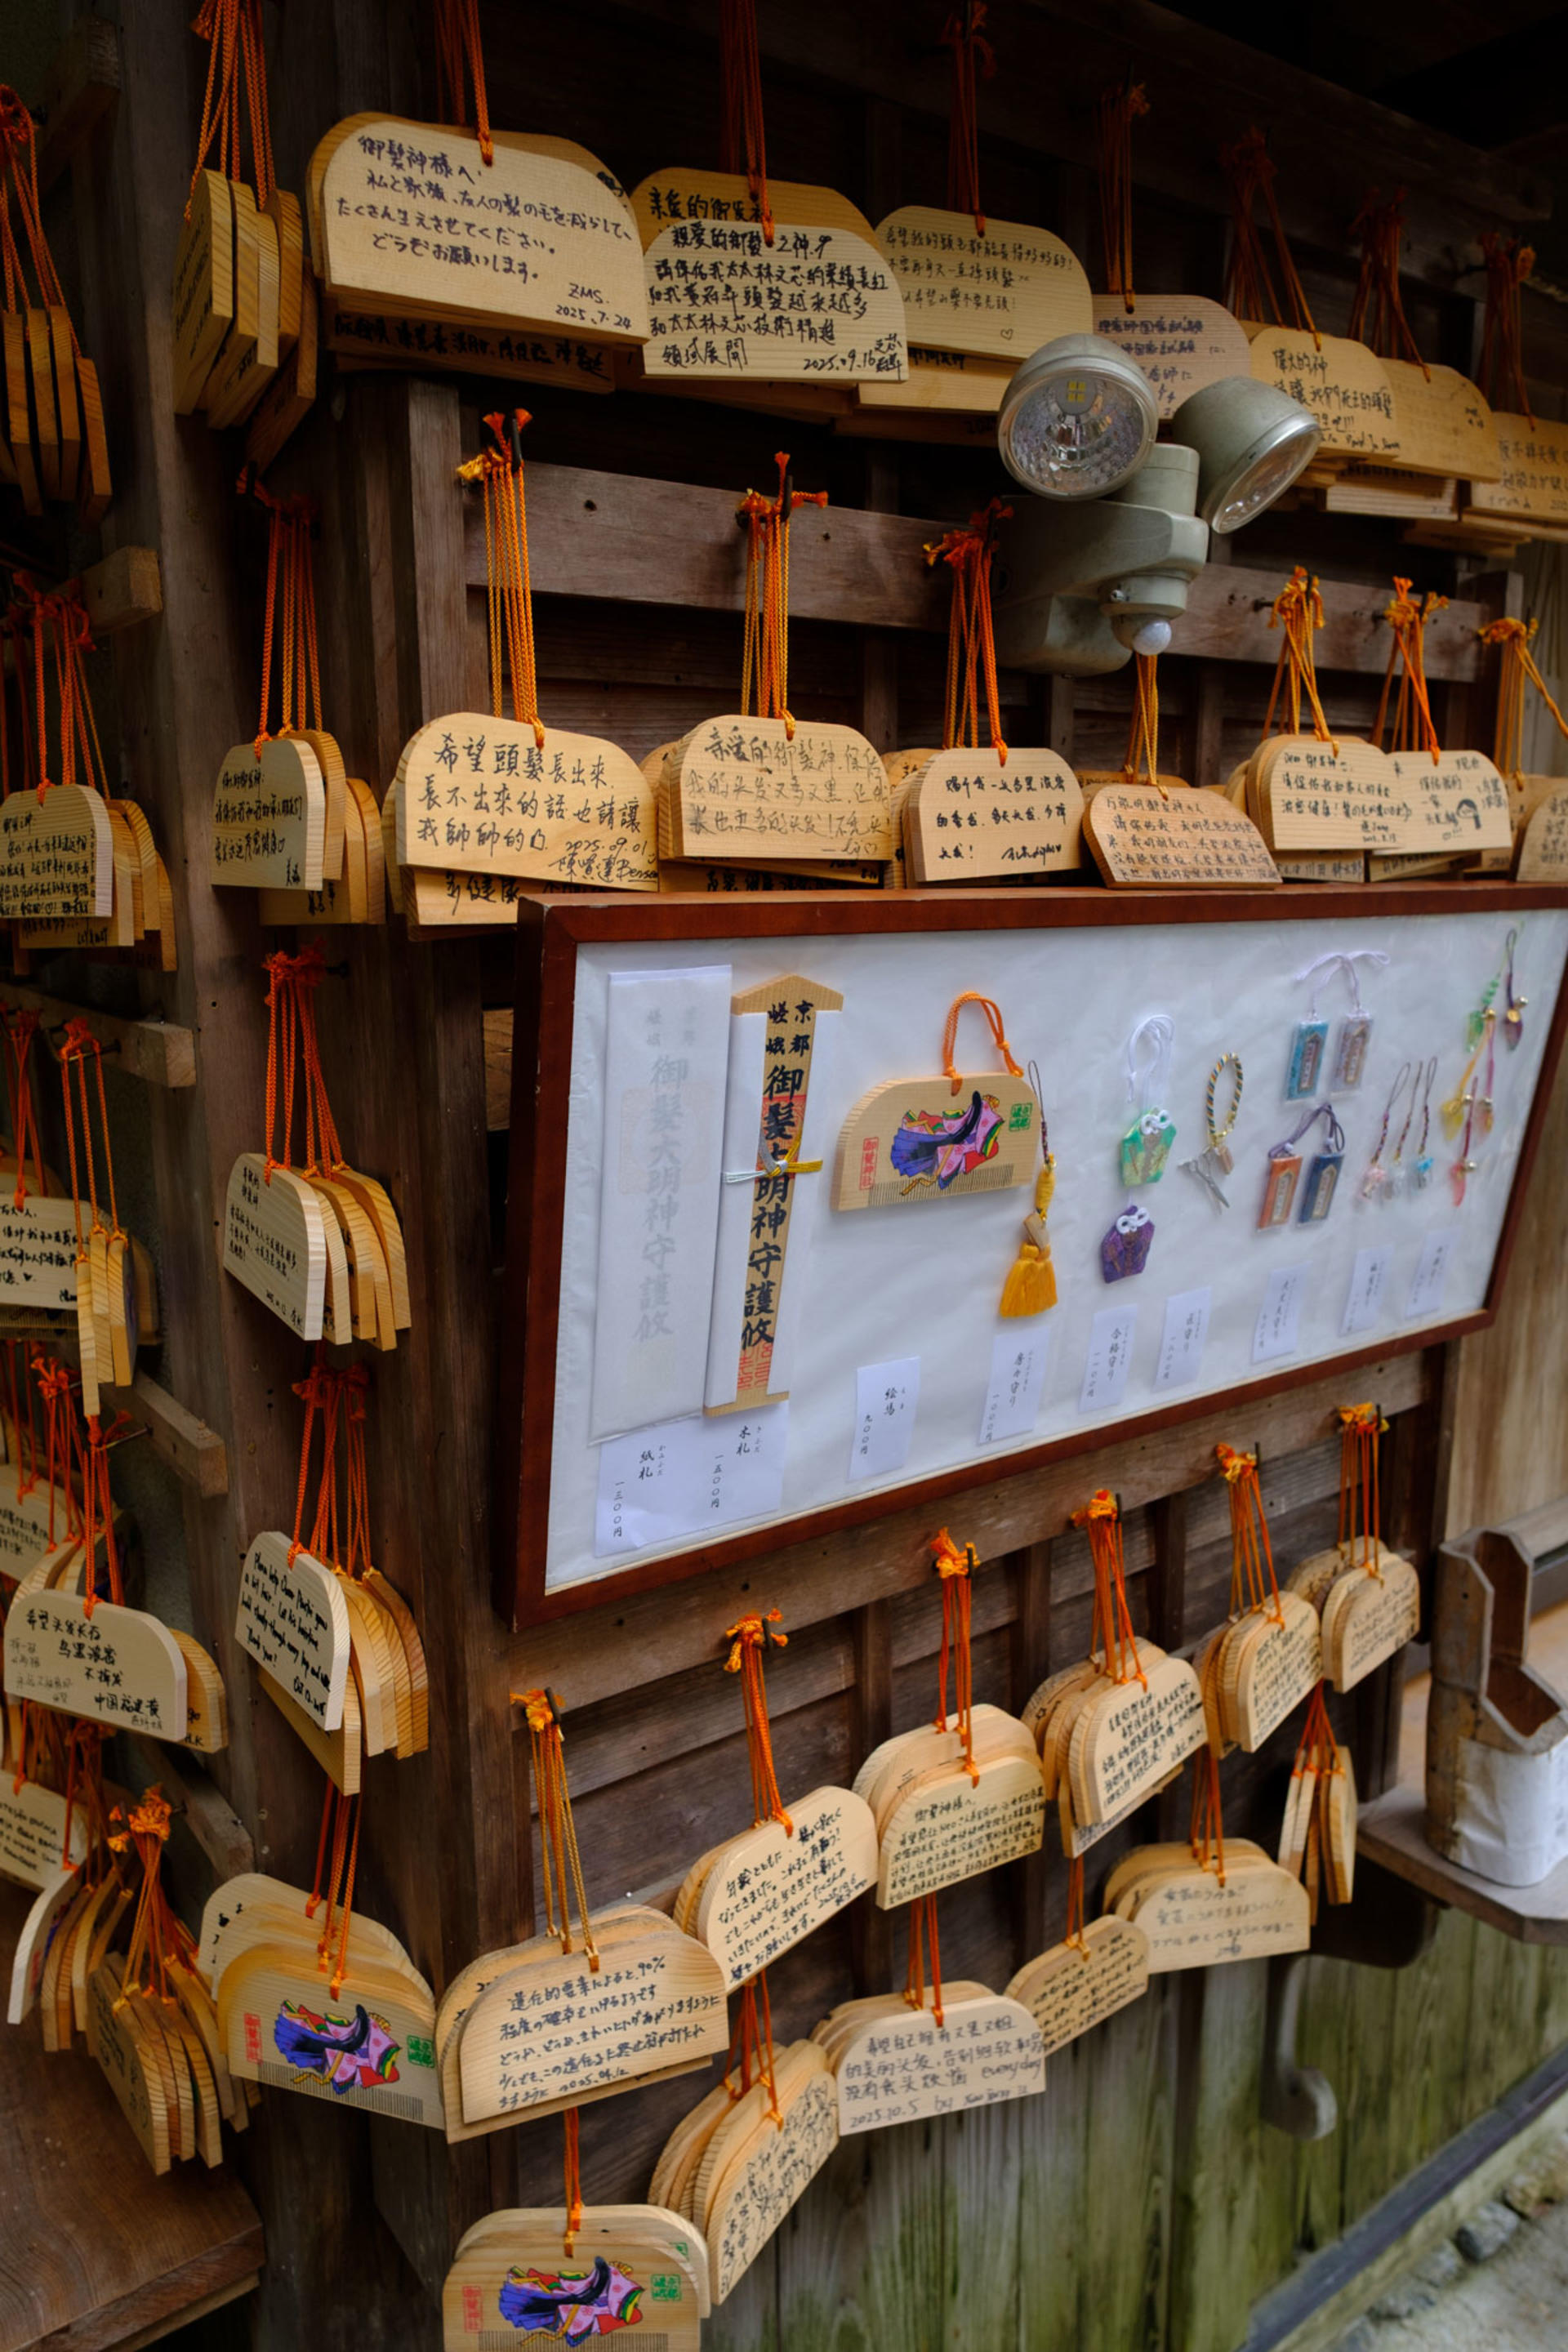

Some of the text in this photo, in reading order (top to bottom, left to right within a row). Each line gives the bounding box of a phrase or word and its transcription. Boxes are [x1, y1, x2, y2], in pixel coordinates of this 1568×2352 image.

[765, 1000, 790, 1055] 嵯峨
[789, 1000, 814, 1058] 京都
[884, 1386, 898, 1416] 絵馬
[736, 1425, 751, 1455] 木札
[639, 1450, 654, 1480] 紙札
